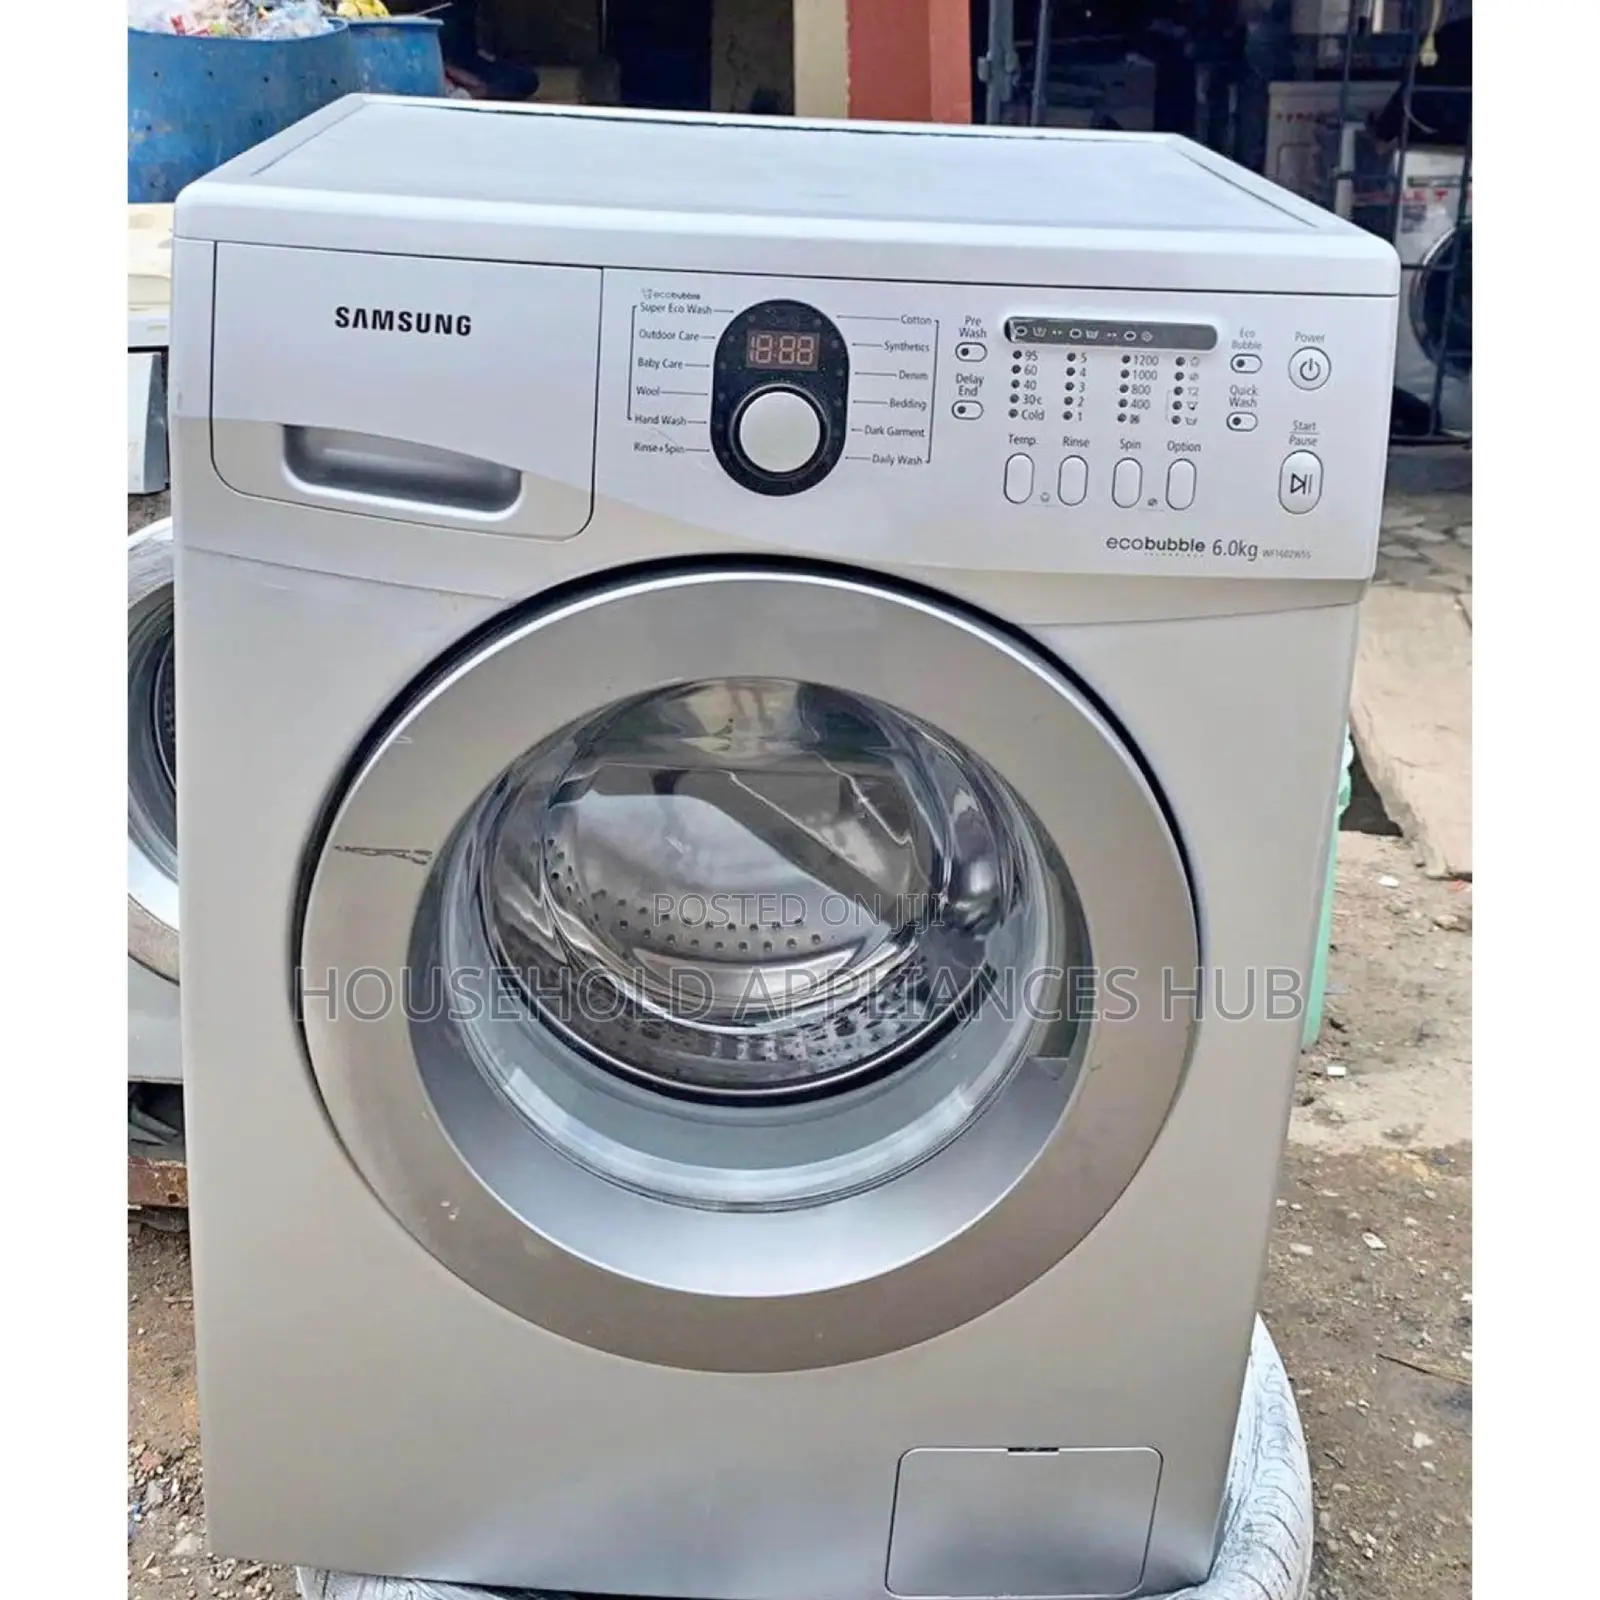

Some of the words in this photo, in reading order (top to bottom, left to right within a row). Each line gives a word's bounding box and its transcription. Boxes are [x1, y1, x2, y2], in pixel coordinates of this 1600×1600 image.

[640, 303, 666, 314] Super
[668, 304, 685, 313] Eco
[686, 304, 712, 315] Wash
[335, 306, 471, 336] SAMSUNG
[901, 315, 932, 325] Cotton
[965, 316, 981, 326] Pre
[639, 330, 676, 341] Outdoor
[678, 332, 699, 341] Care
[959, 328, 987, 338] Wash
[1240, 329, 1256, 338] Eco
[1295, 332, 1325, 342] Power
[884, 341, 930, 353] Synthetics
[1231, 340, 1262, 350] Bubble
[1025, 350, 1038, 361] 95
[1081, 353, 1087, 363] 5
[638, 358, 661, 370] Baby
[662, 359, 683, 369] Care
[1133, 356, 1158, 366] 1200
[899, 370, 928, 380] Denim
[1024, 364, 1038, 376] 60
[1080, 368, 1086, 377] 4
[1132, 370, 1157, 380] 1000
[956, 374, 984, 388] Delay
[1024, 380, 1037, 390] 40
[636, 386, 660, 396] Wool
[959, 387, 978, 396] End
[1079, 382, 1085, 392] 3
[1131, 385, 1150, 395] 800
[1229, 385, 1258, 396] Quick
[890, 398, 927, 411] Bedding
[1078, 397, 1084, 406] 2
[1130, 399, 1150, 409] 400
[1229, 397, 1257, 407] Wash
[1021, 409, 1045, 420] Cold
[635, 414, 660, 425] Hand
[661, 415, 686, 426] Wash
[1293, 420, 1317, 431] Start
[864, 426, 885, 436] Dark
[887, 427, 924, 437] Garment
[1063, 437, 1090, 447] Rinse
[1120, 439, 1141, 450] Spin
[1167, 440, 1201, 451] Option
[1289, 435, 1317, 446] Pause
[872, 453, 895, 465] Daily
[897, 454, 923, 464] Wash
[1106, 537, 1205, 552] ecobubble
[1212, 539, 1258, 562] 6.0kg
